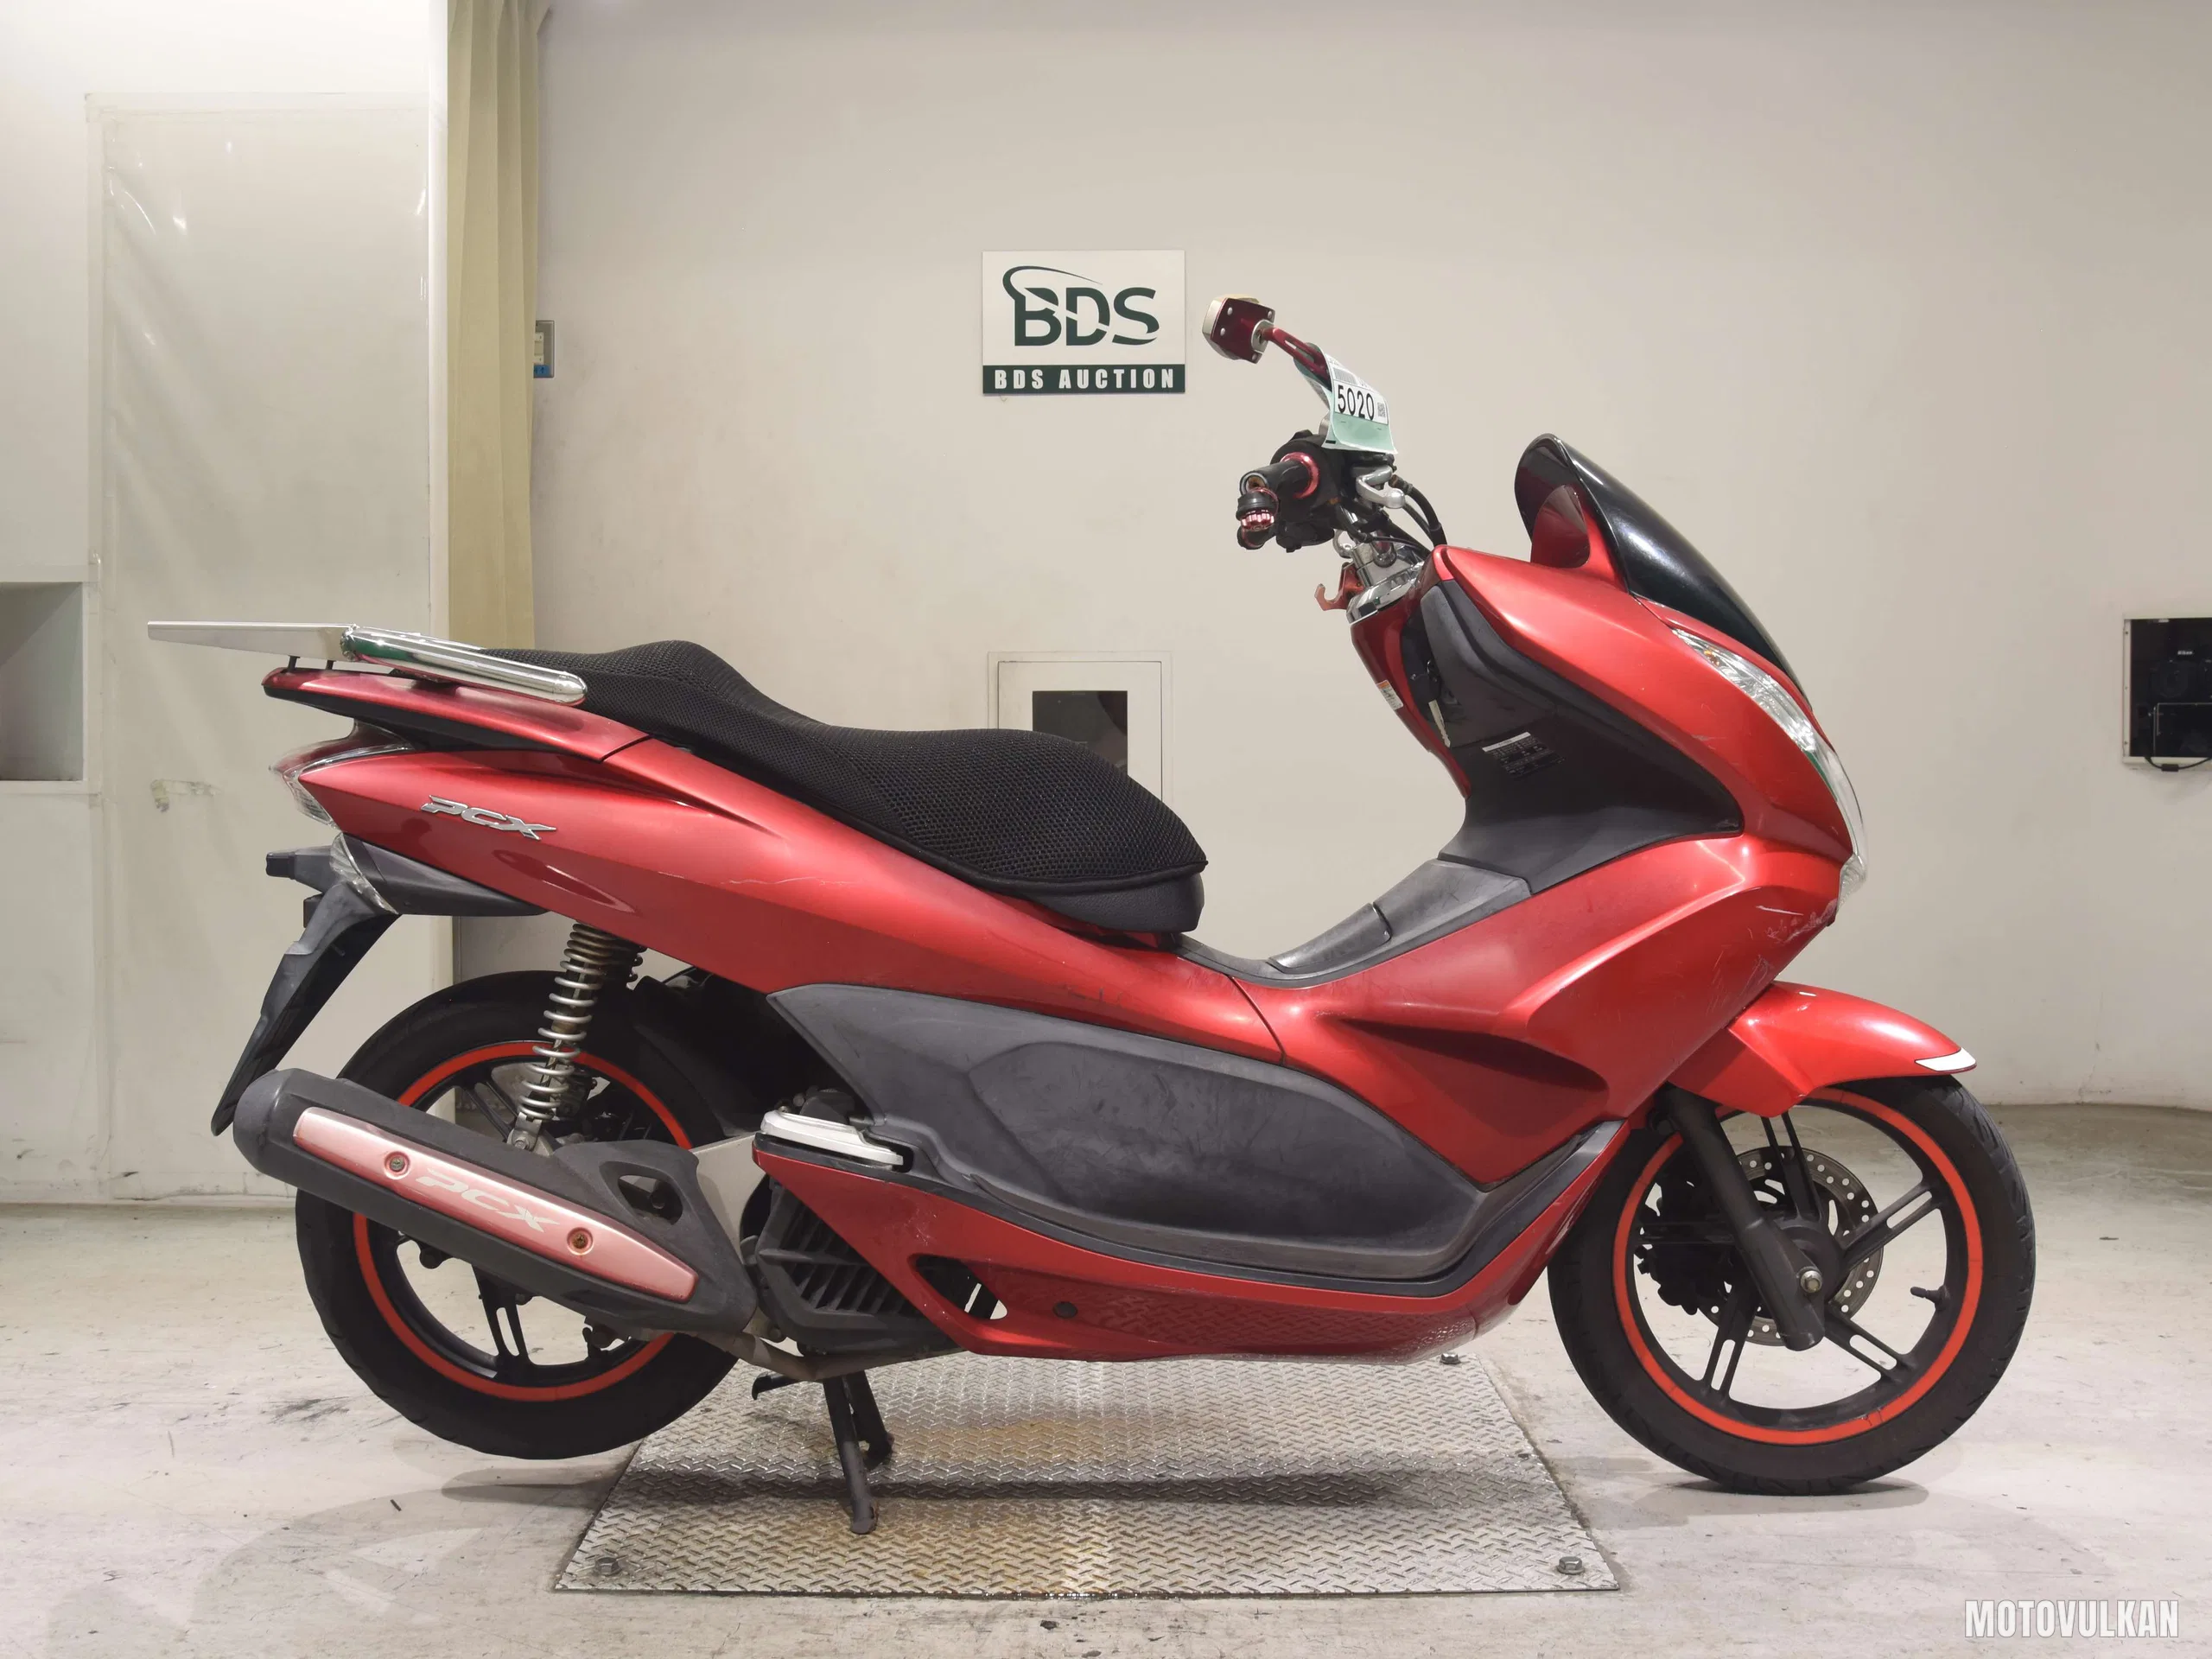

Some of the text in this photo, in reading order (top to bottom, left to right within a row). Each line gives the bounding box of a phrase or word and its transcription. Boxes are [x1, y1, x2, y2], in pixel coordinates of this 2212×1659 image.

[1002, 265, 1160, 346] BDS
[995, 368, 1174, 390] BDS AUCTION
[1337, 384, 1375, 421] 5020
[421, 795, 556, 841] PCX
[415, 1167, 560, 1233] PCX
